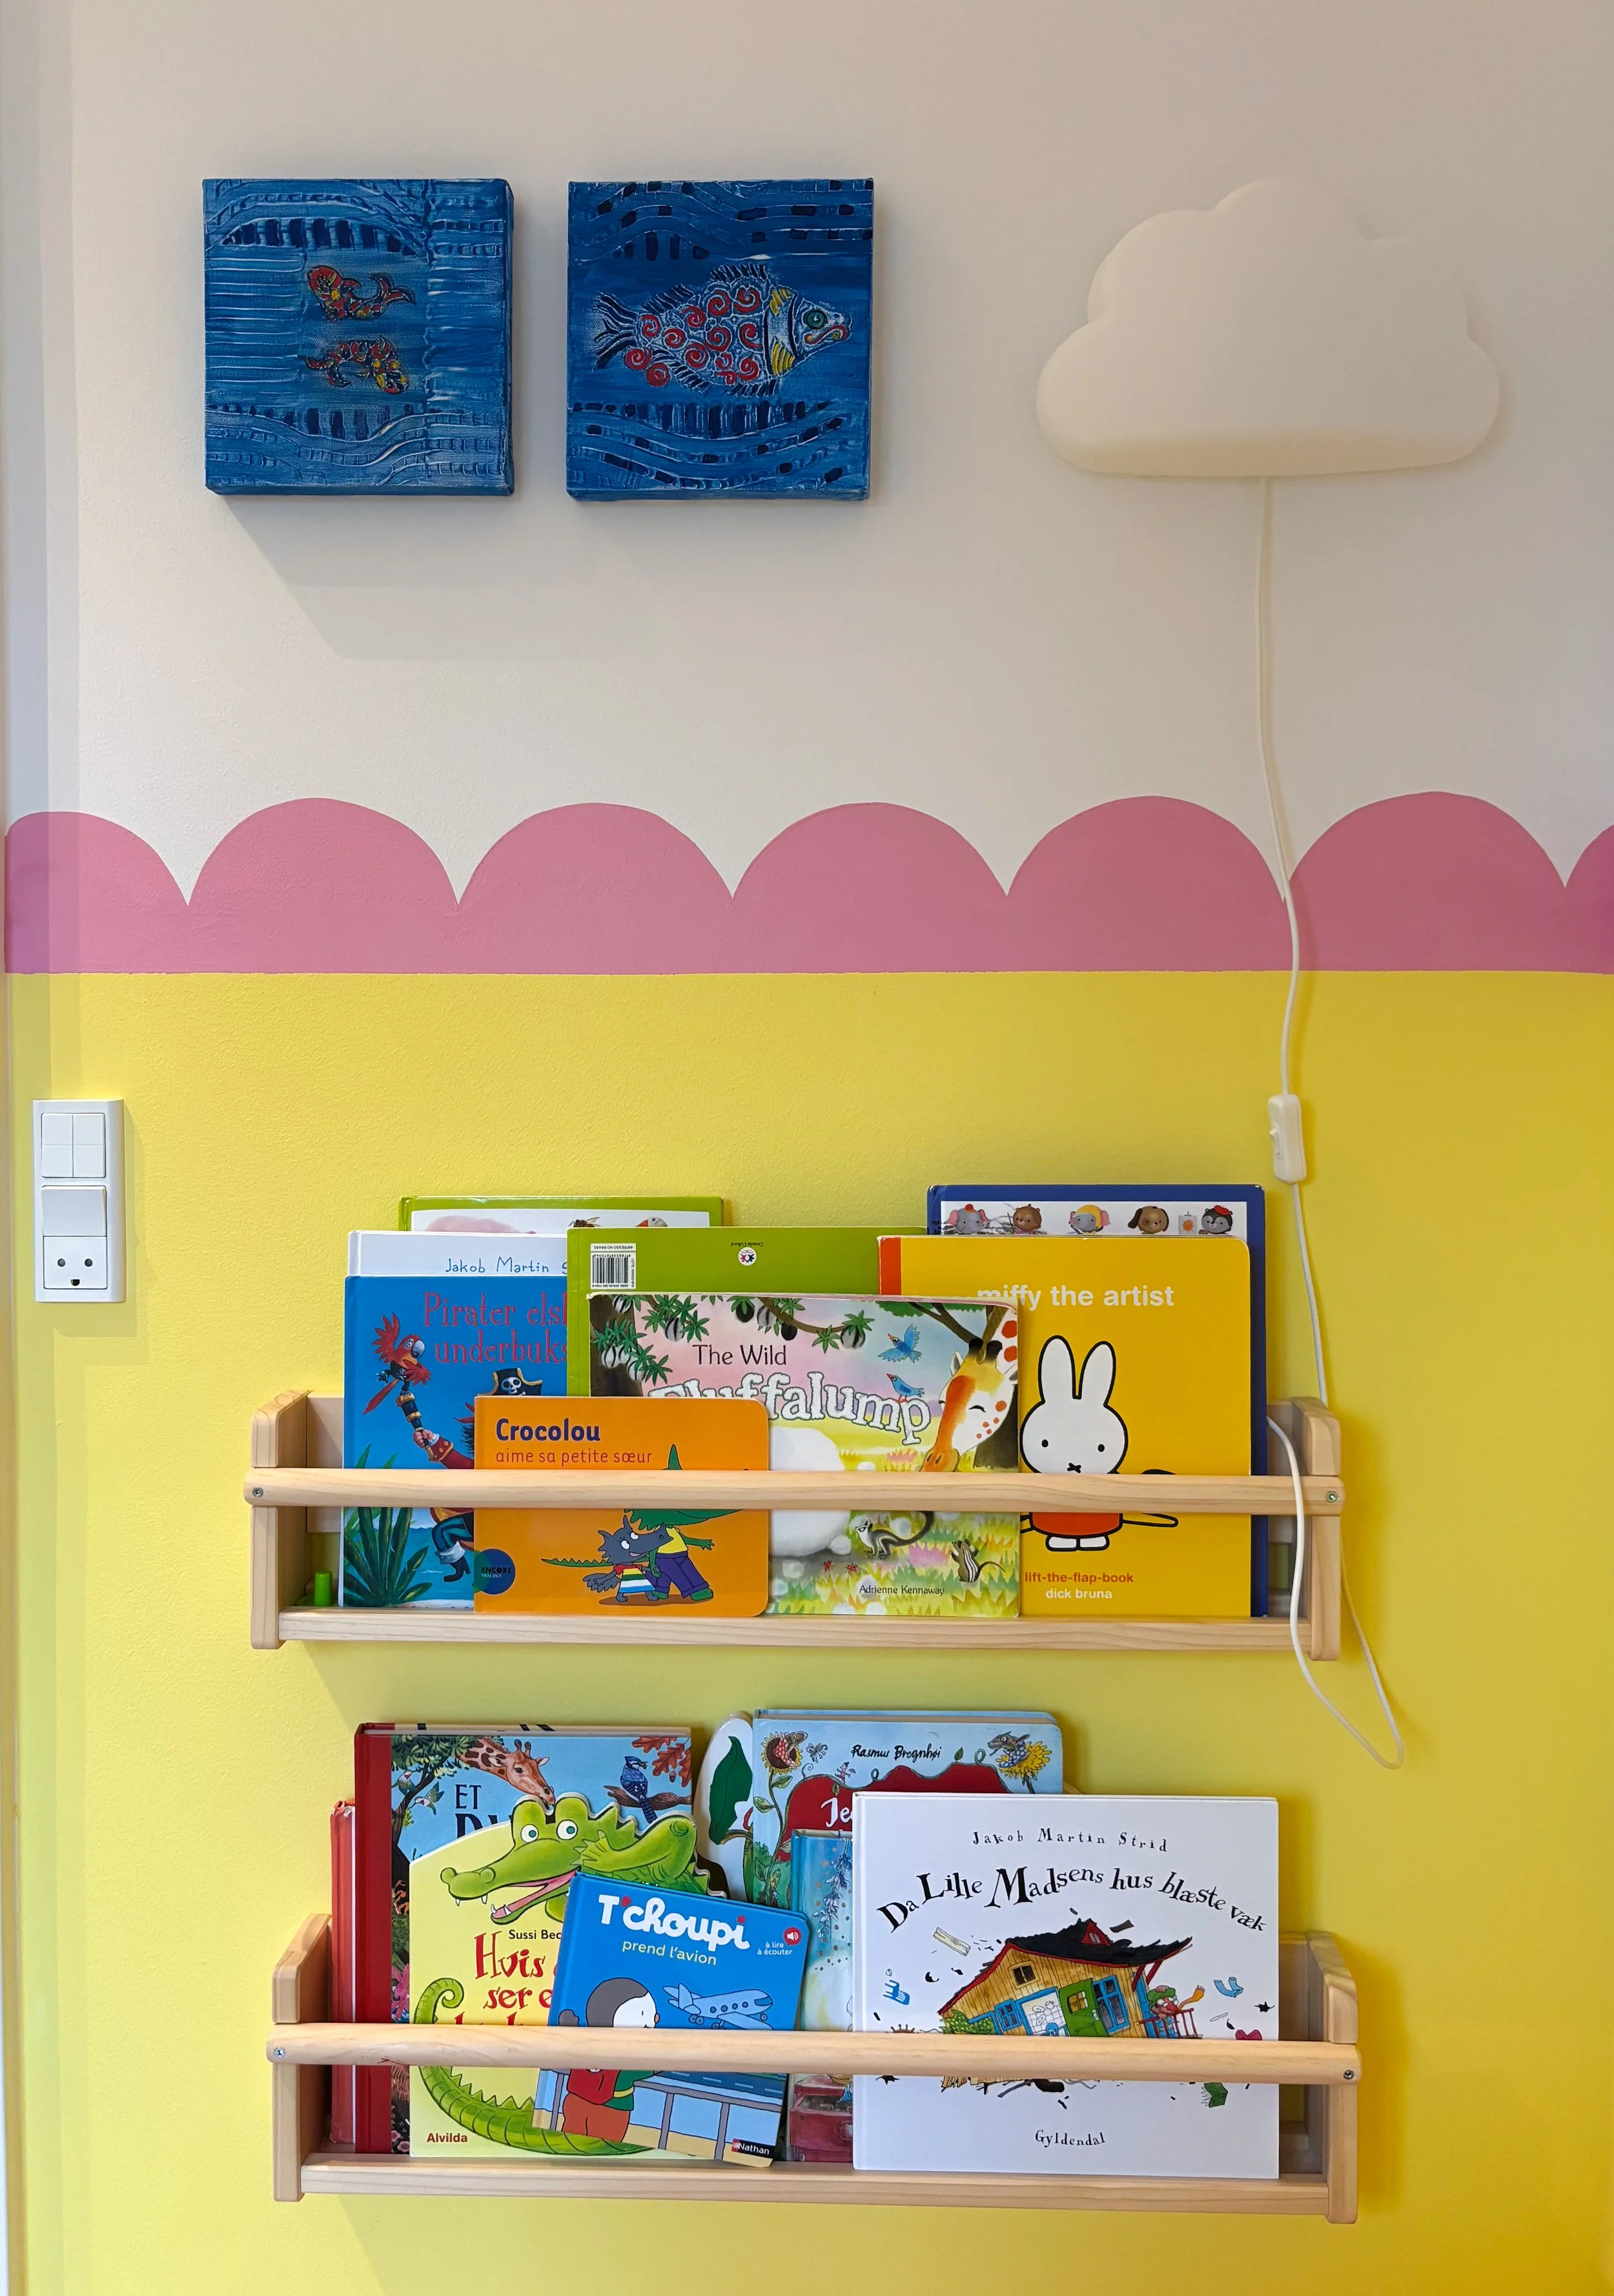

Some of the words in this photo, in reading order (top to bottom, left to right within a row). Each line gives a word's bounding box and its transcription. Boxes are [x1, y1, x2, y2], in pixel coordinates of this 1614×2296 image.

[445, 1258, 485, 1273] Jakob
[496, 1256, 549, 1273] Martin
[1050, 1284, 1094, 1306] the
[1103, 1285, 1174, 1306] artist
[424, 1291, 516, 1327] Pirater
[692, 1344, 733, 1365] The
[740, 1344, 787, 1365] Wild
[496, 1417, 600, 1441] Crocolou
[496, 1448, 534, 1463] aime
[538, 1451, 555, 1463] sa
[562, 1448, 608, 1467] petite
[613, 1451, 653, 1464] sœur
[1025, 1572, 1134, 1584] lift-the-flap-book
[859, 1584, 898, 1595] Adrienne
[901, 1585, 945, 1597] Kennaway
[1045, 1588, 1072, 1599] dick
[1075, 1588, 1112, 1599] bruna
[851, 1744, 890, 1759] Rasmus
[455, 1784, 482, 1810] ET
[821, 1797, 853, 1828] Je
[973, 1830, 1023, 1845] Jakob
[1037, 1827, 1105, 1844] Martin
[1119, 1832, 1167, 1852] Strid
[876, 1900, 919, 1933] Da
[916, 1872, 983, 1905] Lille
[984, 1866, 1104, 1908] Madsens
[1108, 1868, 1154, 1890] hus
[1158, 1871, 1226, 1911] blæste
[1230, 1905, 1267, 1931] væk
[598, 1894, 750, 1952] T'choupi
[509, 1929, 536, 1940] Sussi
[475, 1931, 546, 1980] Hvis
[622, 1940, 666, 1956] prend
[669, 1945, 717, 1965] l'avion
[483, 1987, 533, 2010] ser
[427, 2133, 468, 2142] Alvilda
[1035, 2129, 1106, 2147] Gyldendal
[738, 2142, 770, 2155] Nathan
